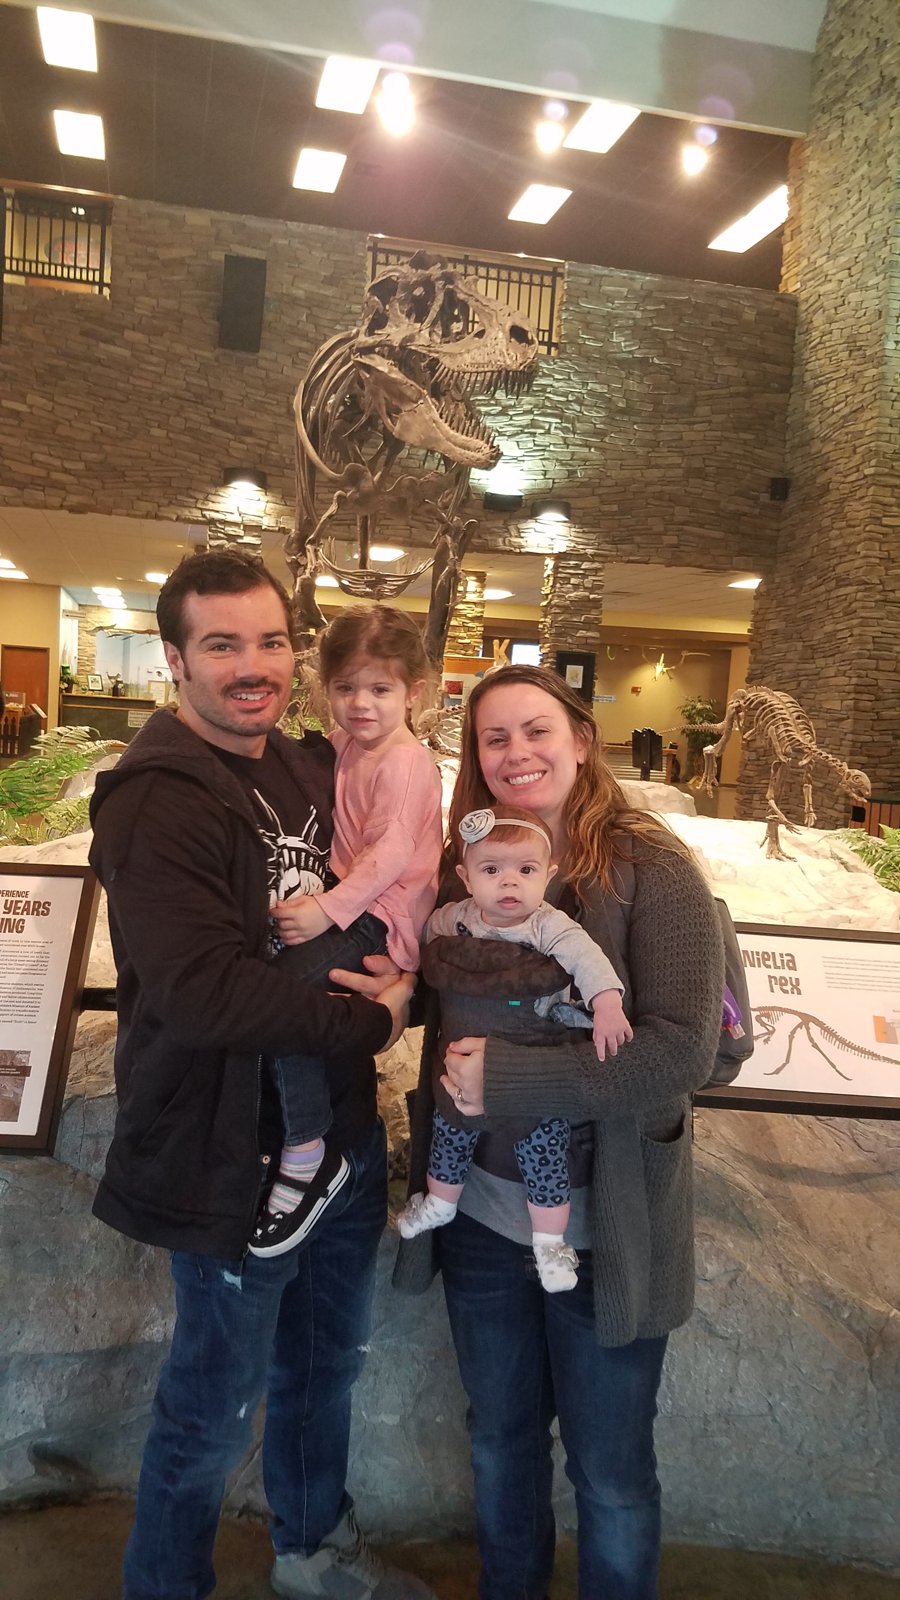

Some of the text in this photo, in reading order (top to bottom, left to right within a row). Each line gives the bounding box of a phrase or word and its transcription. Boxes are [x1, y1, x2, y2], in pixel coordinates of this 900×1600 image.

[0, 889, 30, 898] ERIENCE
[2, 899, 52, 917] YEARS
[767, 974, 803, 996] rex
